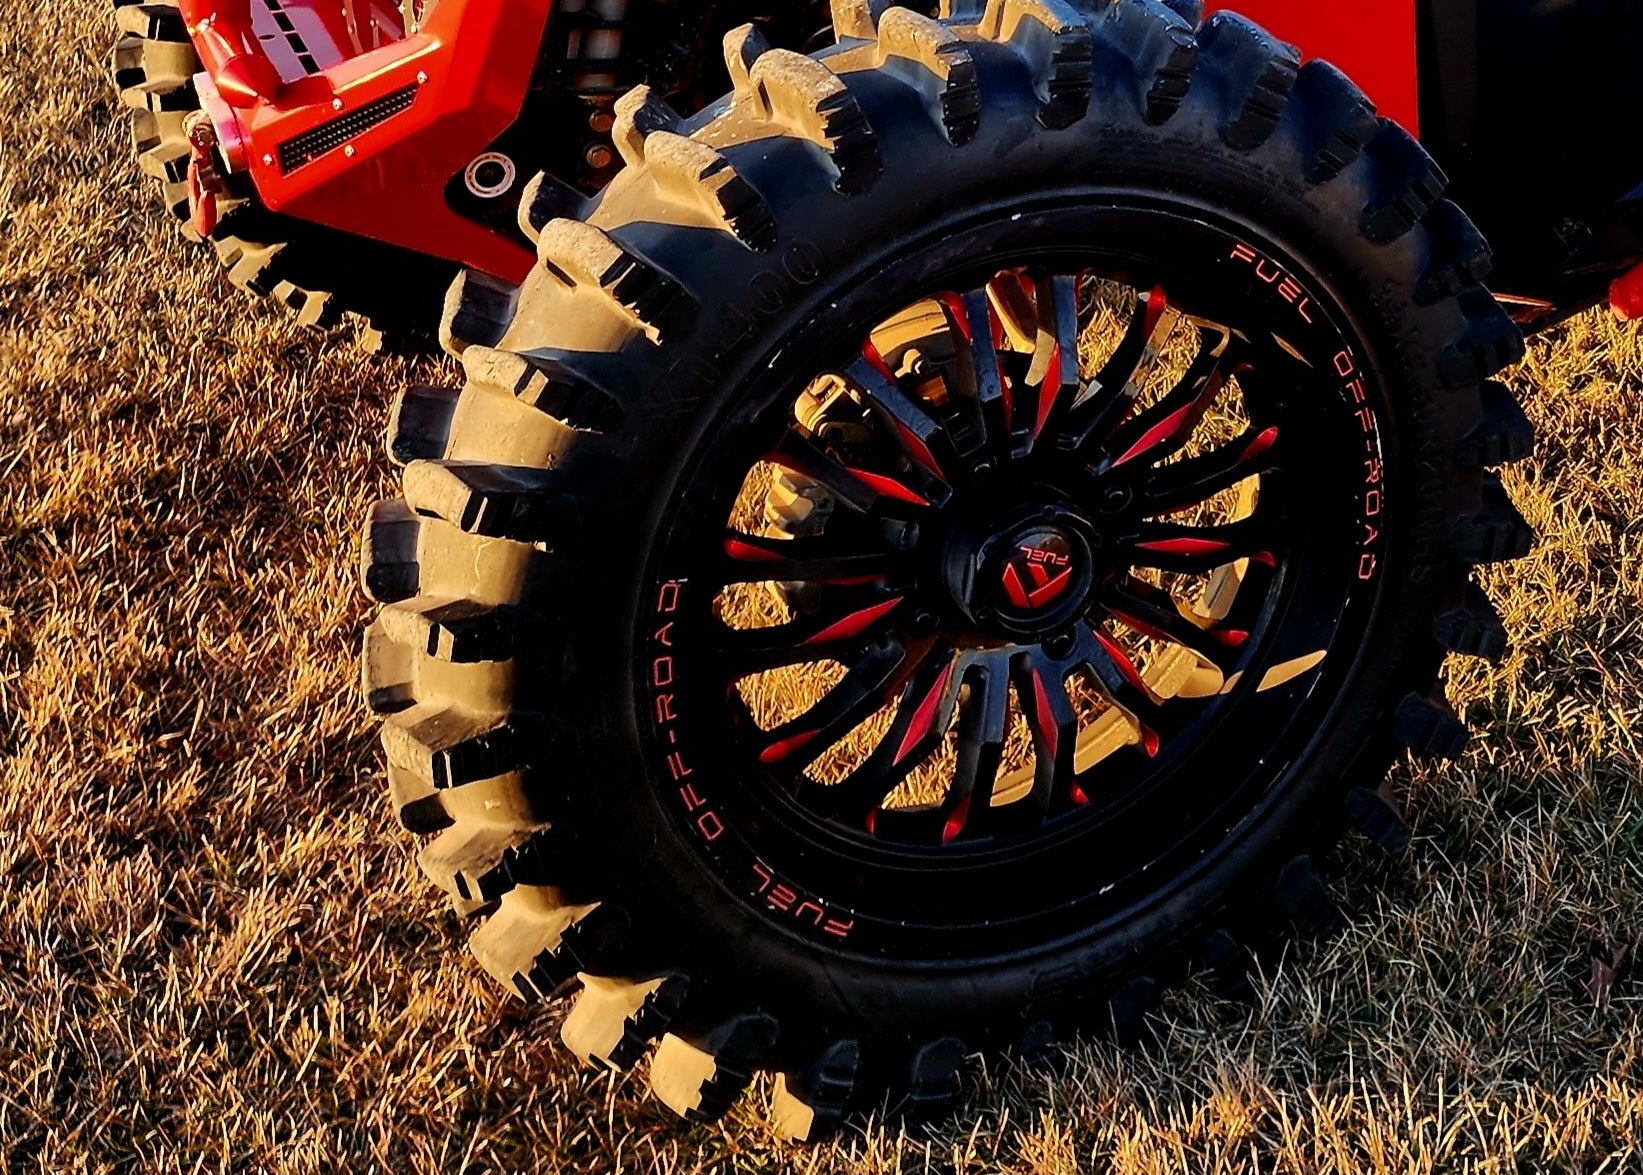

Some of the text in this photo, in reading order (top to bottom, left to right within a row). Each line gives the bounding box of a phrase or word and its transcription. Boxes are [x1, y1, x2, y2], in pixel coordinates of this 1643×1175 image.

[1020, 545, 1070, 567] FUEL
[1230, 243, 1381, 581] FUEL OFF-ROAD
[653, 581, 855, 938] FUEL OFF-ROAD
